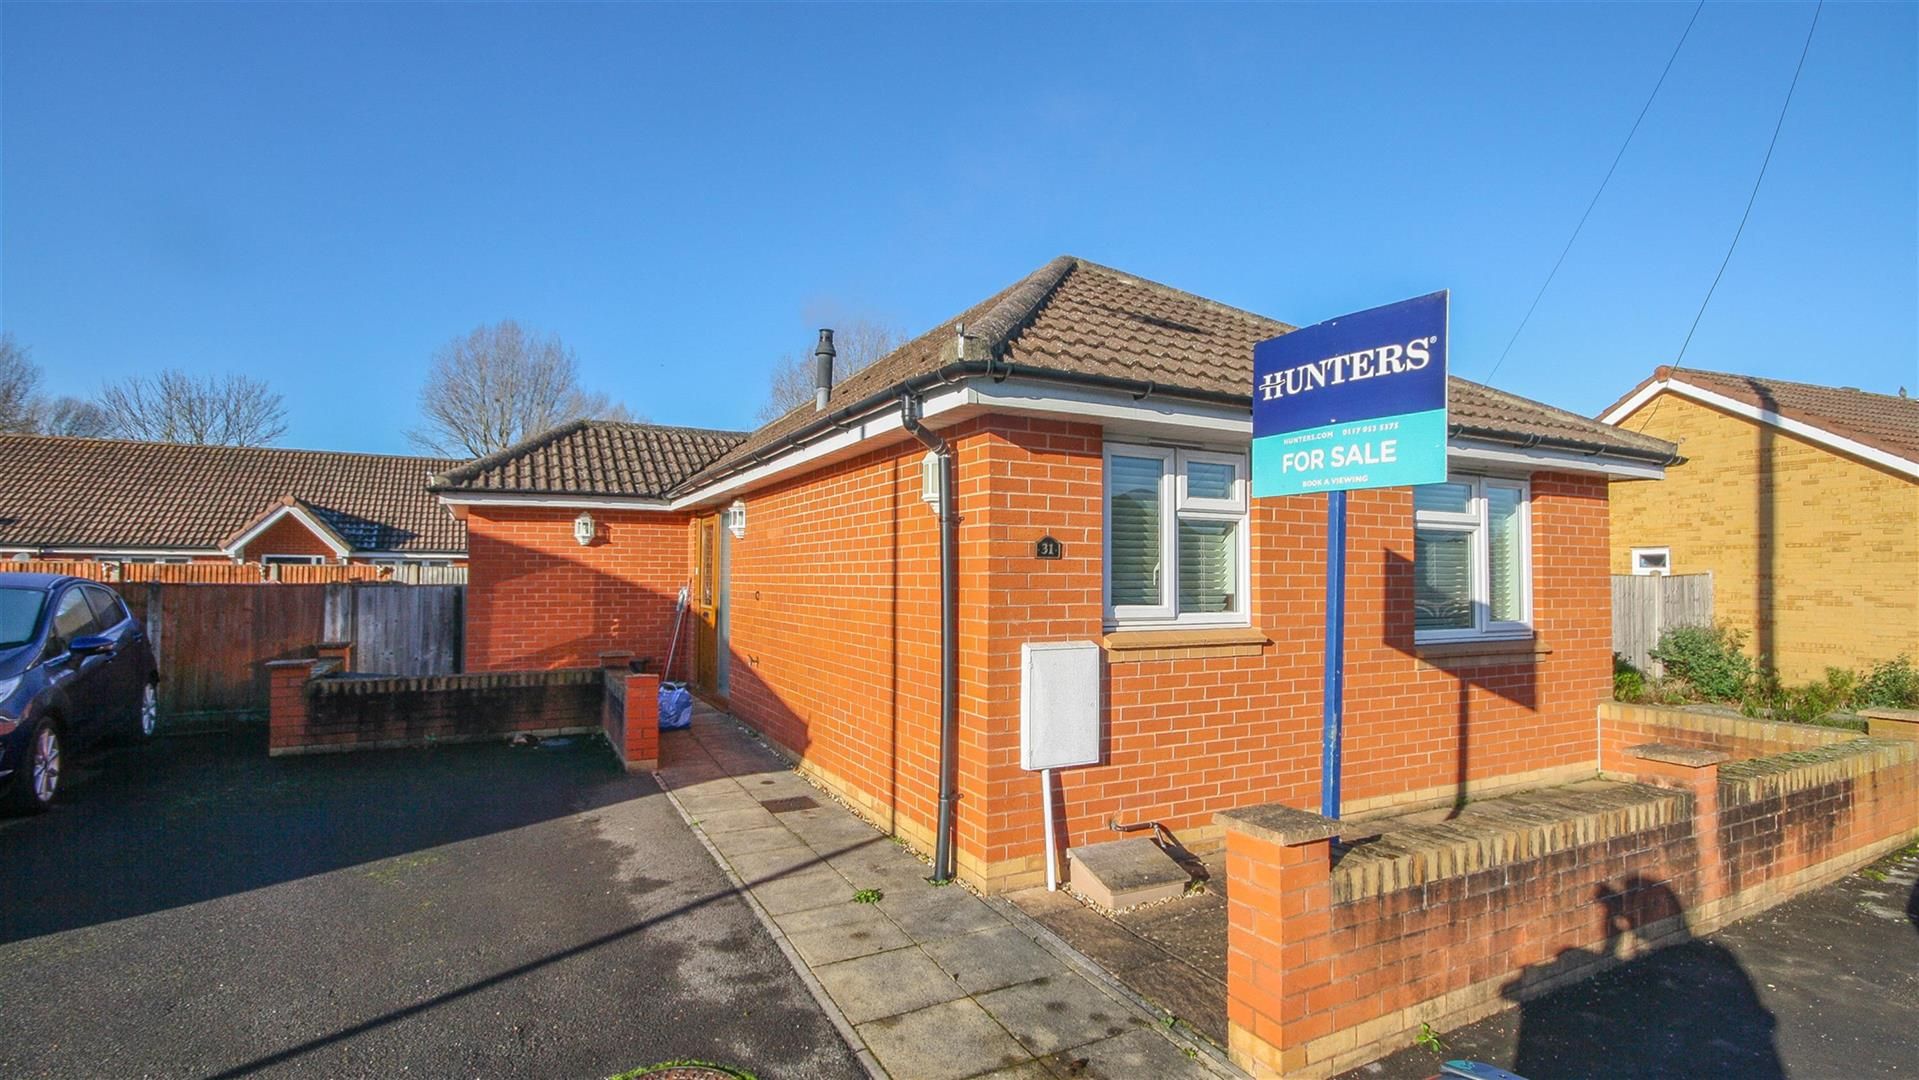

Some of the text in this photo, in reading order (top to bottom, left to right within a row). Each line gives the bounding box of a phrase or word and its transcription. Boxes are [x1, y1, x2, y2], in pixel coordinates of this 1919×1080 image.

[1283, 431, 1334, 445] HUNTERS.COM
[1342, 427, 1361, 436] 0117
[1282, 439, 1398, 474] FOR SALE
[1302, 475, 1369, 488] BOOK A VIEWING
[1040, 543, 1055, 555] 31
